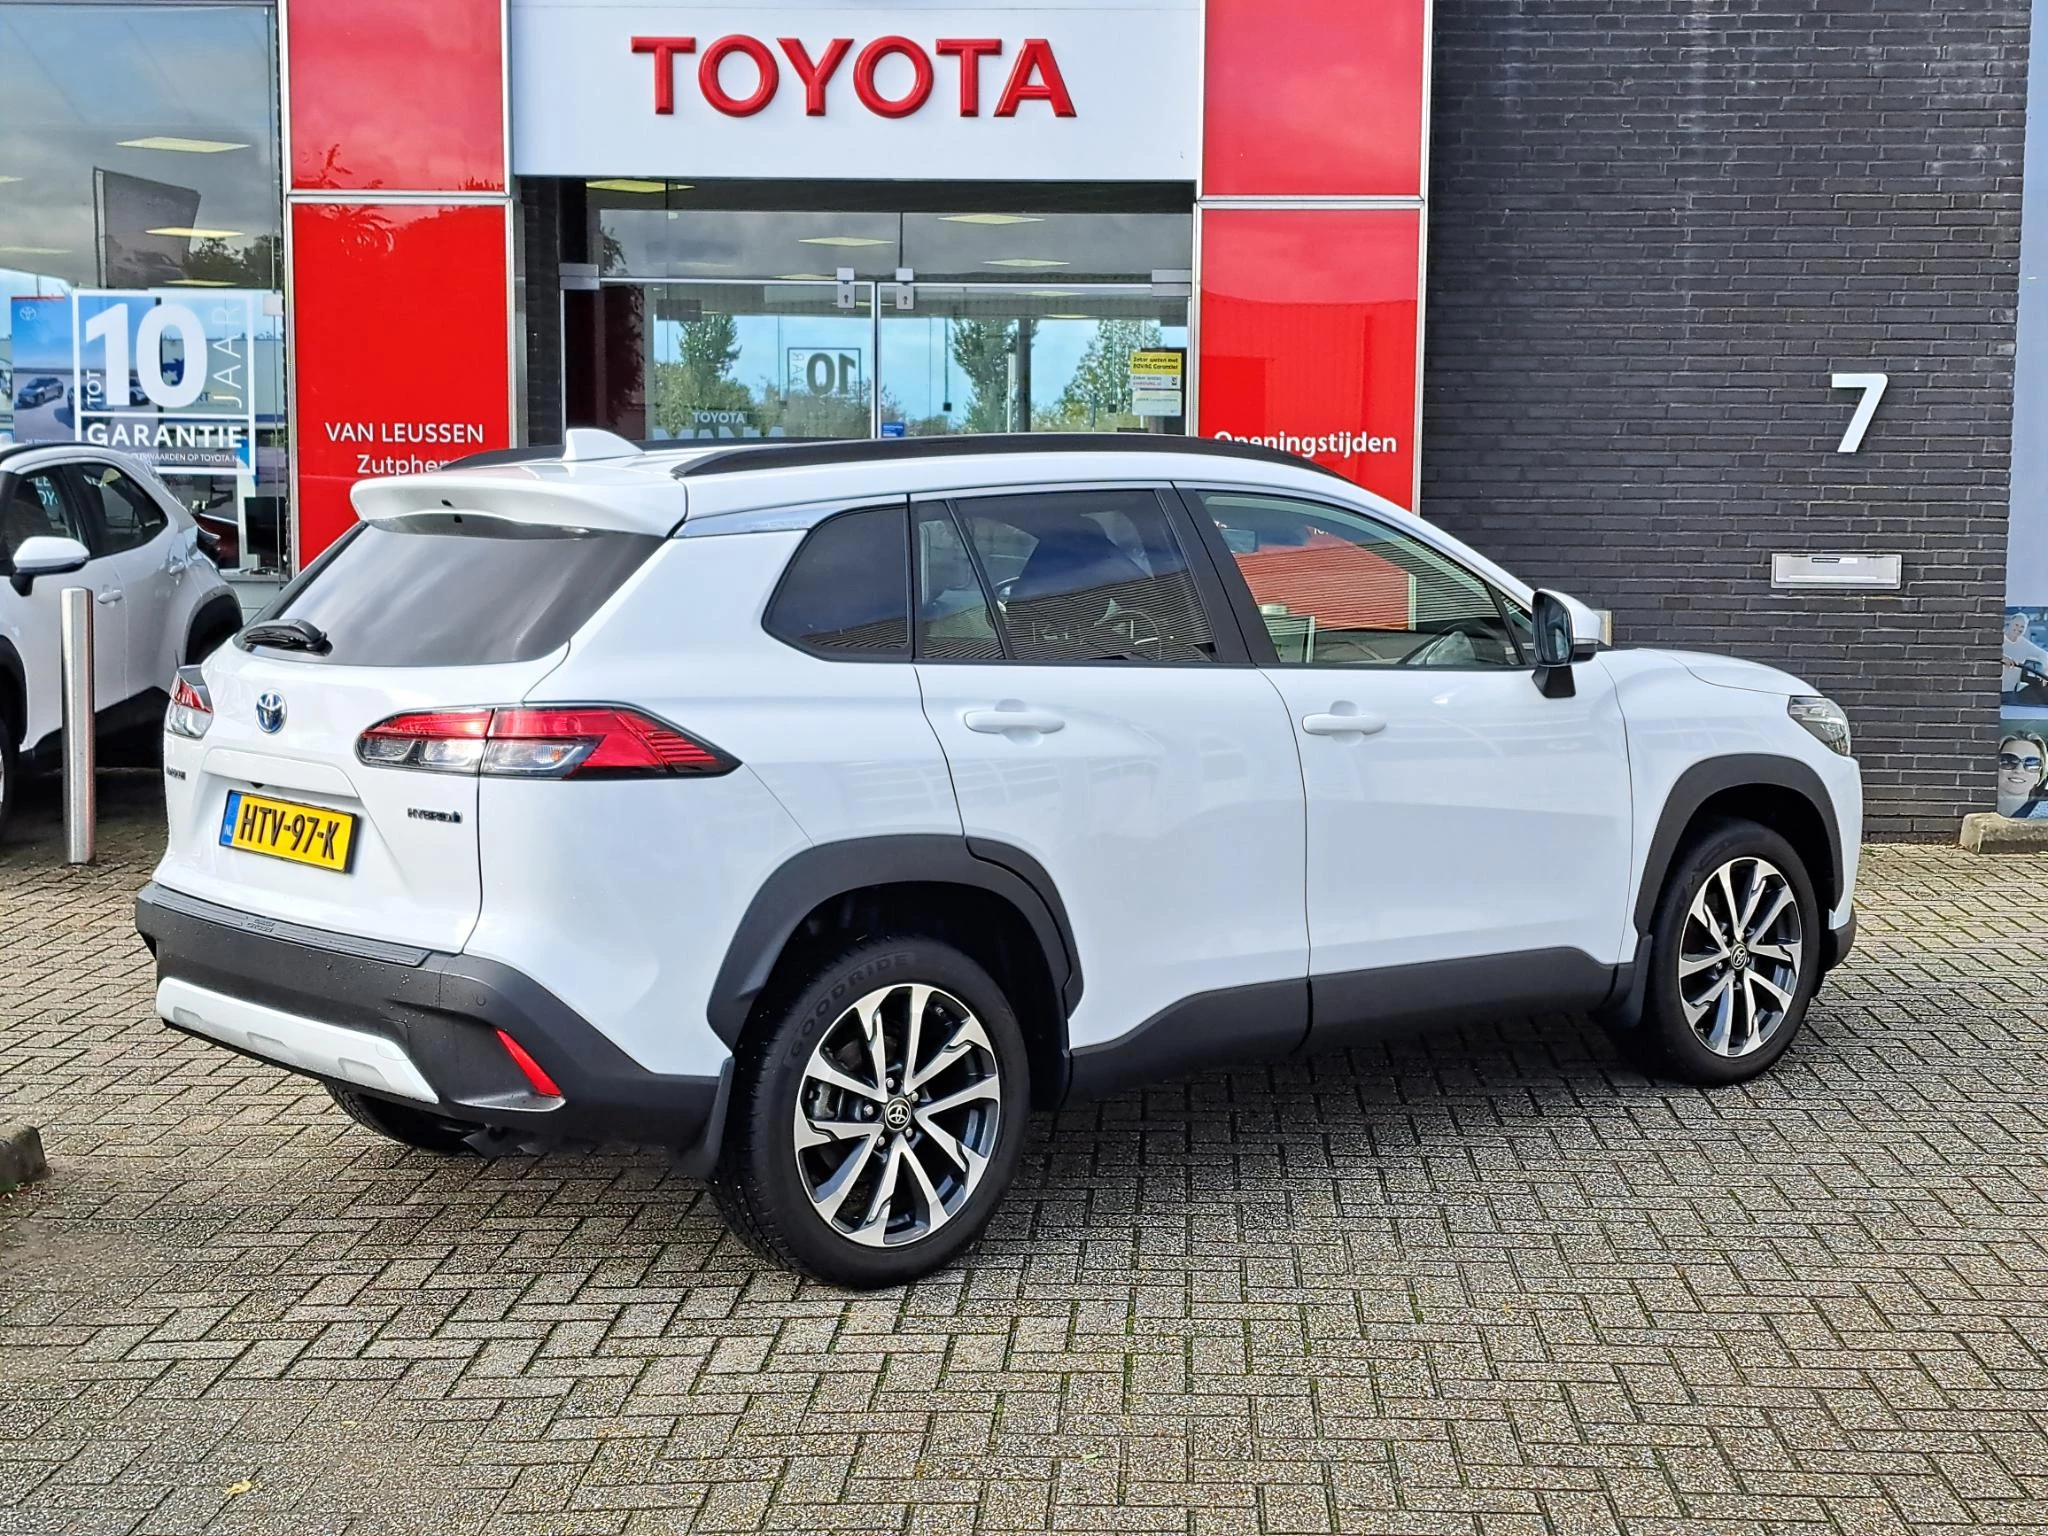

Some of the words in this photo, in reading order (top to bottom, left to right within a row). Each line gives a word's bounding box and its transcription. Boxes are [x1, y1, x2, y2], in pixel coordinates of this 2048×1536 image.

[631, 34, 1077, 119] TOYOTA
[85, 303, 208, 408] 10
[211, 305, 242, 409] JAAR
[87, 369, 102, 406] TOT
[87, 423, 242, 448] GARANTIE
[325, 422, 374, 442] VAN
[381, 423, 484, 443] LEUSSEN
[691, 411, 745, 424] TOYOTA
[1831, 373, 1888, 453] 7
[357, 453, 451, 476] Zutphe
[1213, 431, 1397, 458] ningstijden
[239, 803, 340, 860] HTV-97-K
[790, 954, 910, 1058] GOODRIDE
